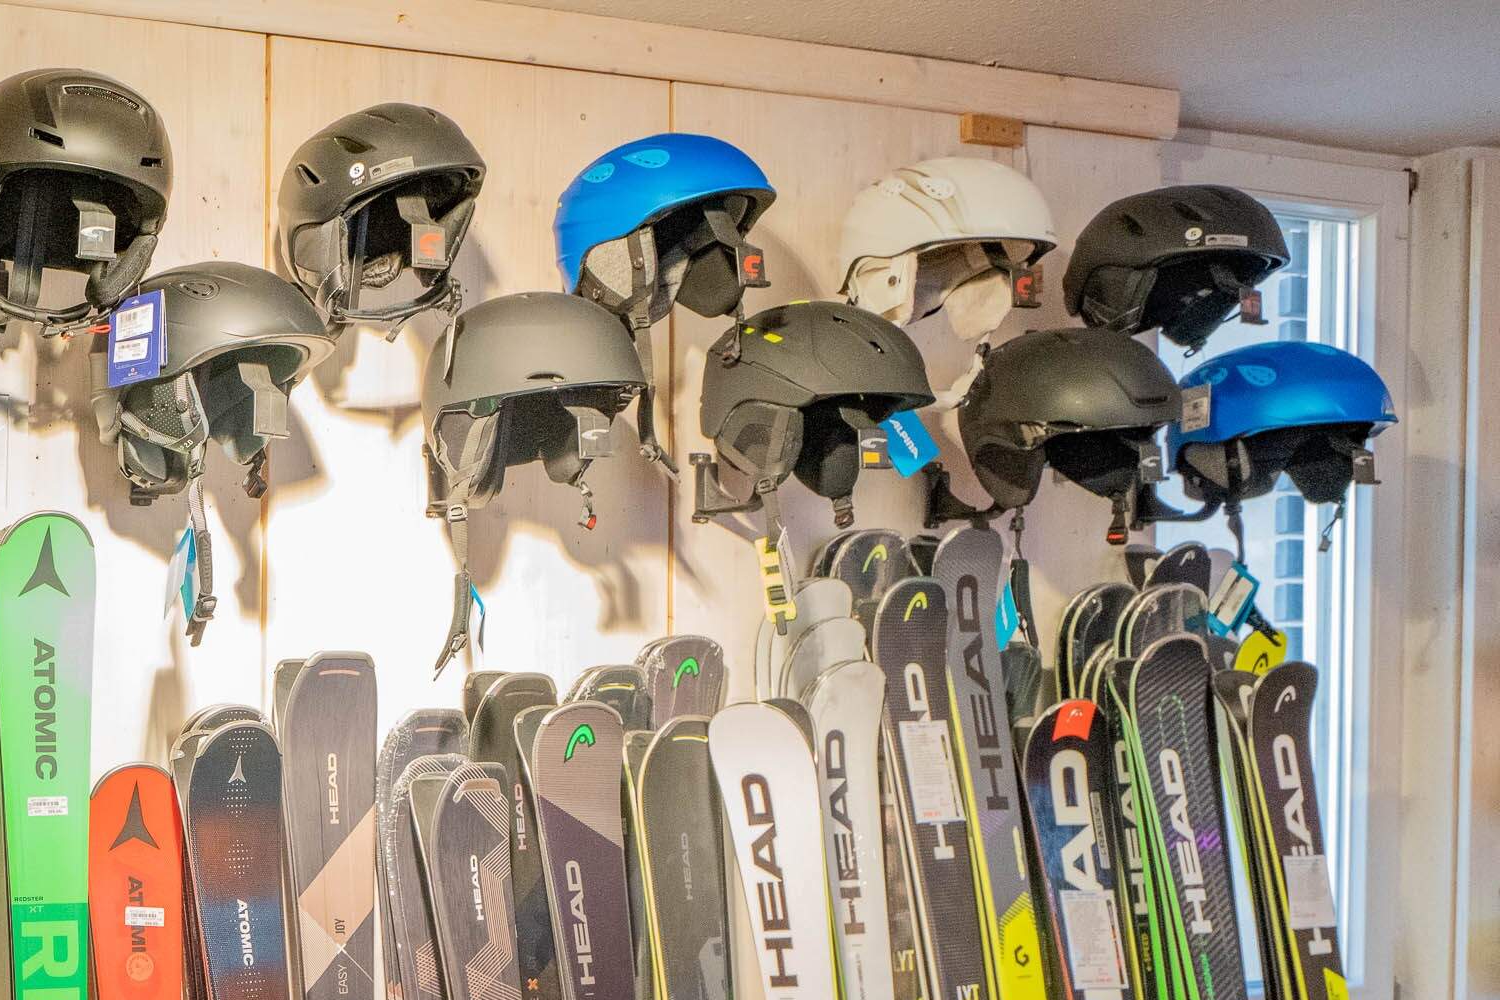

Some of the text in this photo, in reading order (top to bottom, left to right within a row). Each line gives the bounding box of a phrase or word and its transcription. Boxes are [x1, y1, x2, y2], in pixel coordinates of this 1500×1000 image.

[888, 419, 919, 460] ALPINA
[33, 637, 58, 781] ATOMIC
[955, 574, 1010, 812] HEAD
[326, 752, 340, 825] HEAD
[904, 661, 955, 860] HD
[513, 783, 528, 851] HEAD
[824, 728, 866, 936] HEAD
[1158, 747, 1213, 935] HEAD
[1272, 733, 1334, 956] HAD
[469, 854, 485, 921] HEAD
[680, 832, 694, 901] HEAD
[740, 772, 799, 988] HEAD
[29, 905, 45, 913] XT
[127, 876, 147, 953] ATMI
[236, 898, 254, 967] ATOMIC
[564, 860, 596, 986] HEAD
[334, 918, 349, 995] EASY JOY
[894, 949, 915, 974] YT
